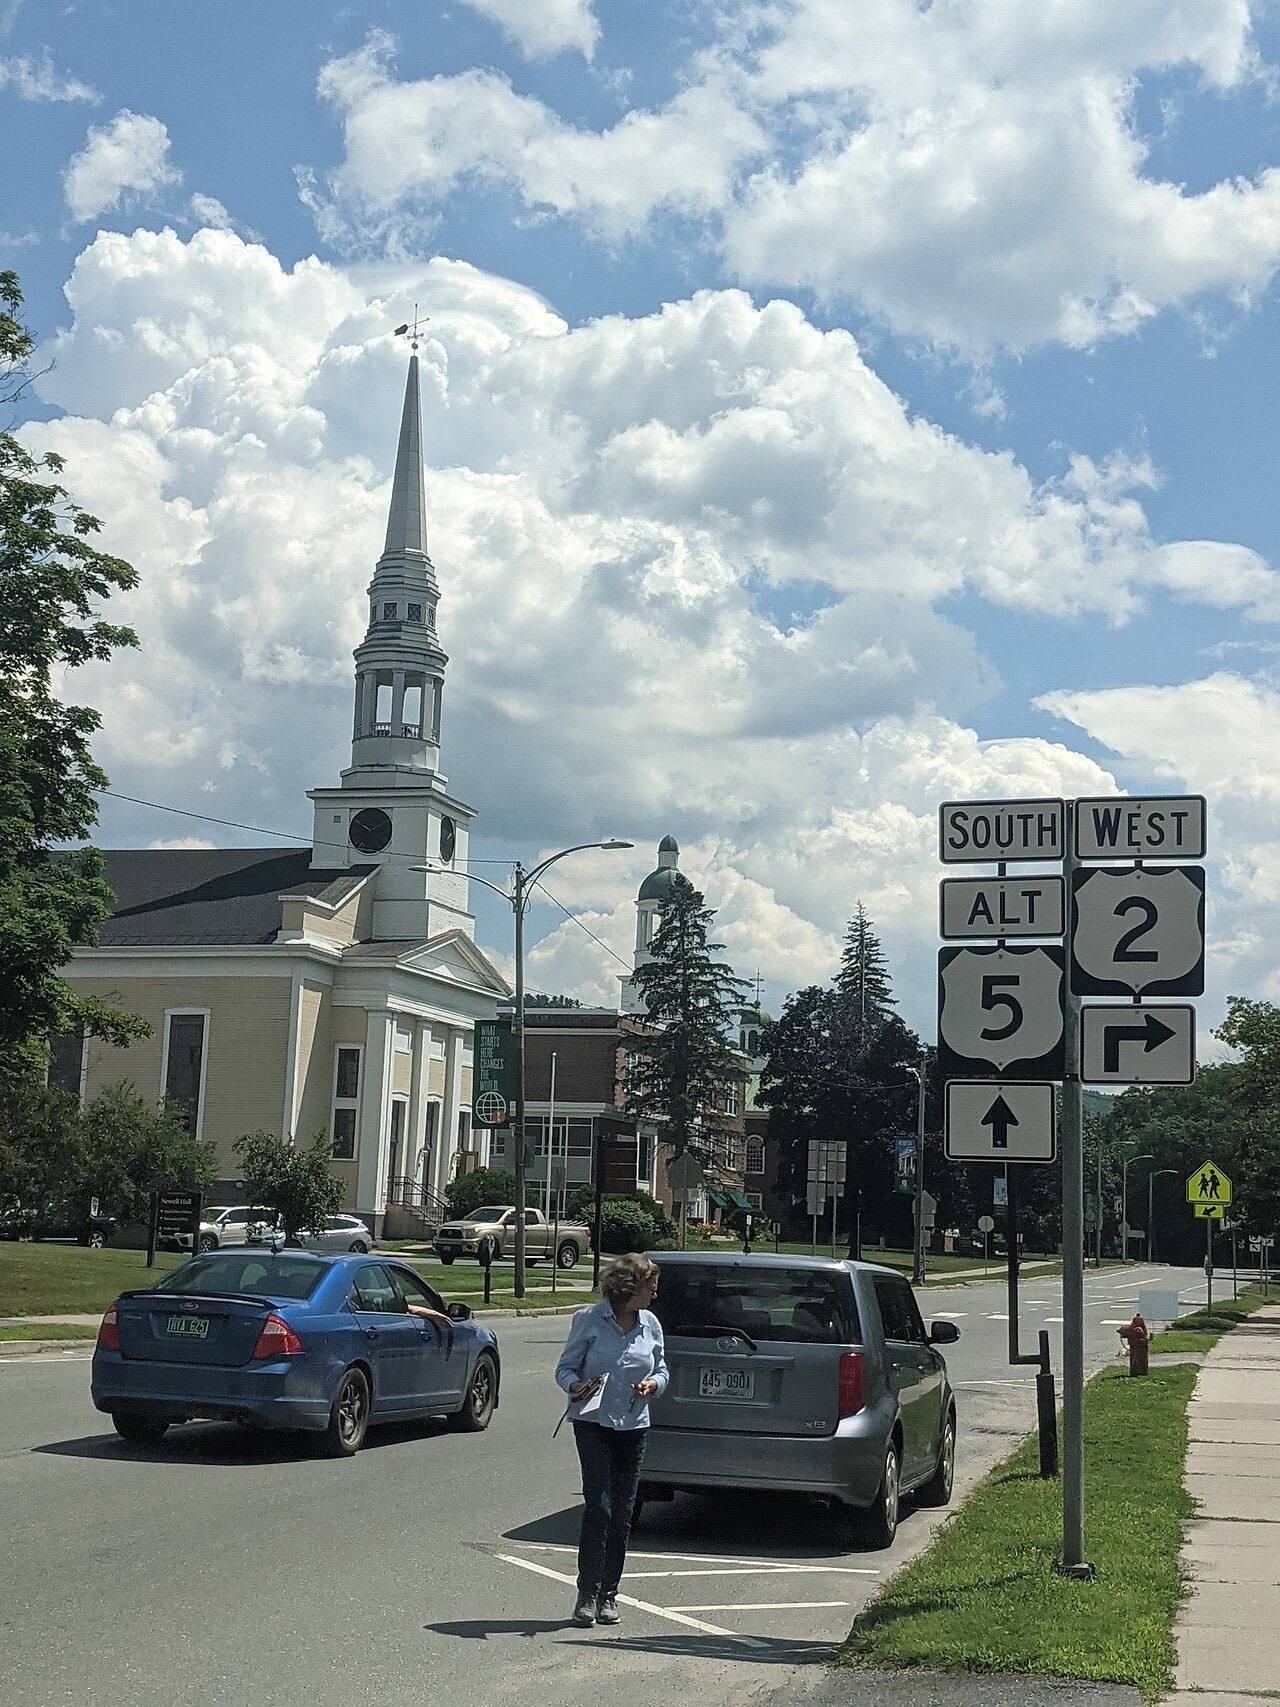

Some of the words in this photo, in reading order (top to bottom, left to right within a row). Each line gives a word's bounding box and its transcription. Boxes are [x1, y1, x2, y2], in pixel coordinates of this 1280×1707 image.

[948, 811, 1057, 850] SOUTH
[1092, 807, 1189, 847] WEST
[967, 890, 1042, 926] ALT
[1112, 895, 1159, 963] 2
[979, 974, 1024, 1041] 5
[482, 1025, 496, 1036] WHAT
[481, 1036, 501, 1047] STARTS
[481, 1047, 494, 1058] HERE
[481, 1058, 504, 1070] CHANGES
[481, 1069, 490, 1080] THE
[189, 1319, 205, 1332] 625
[702, 1372, 721, 1388] 445
